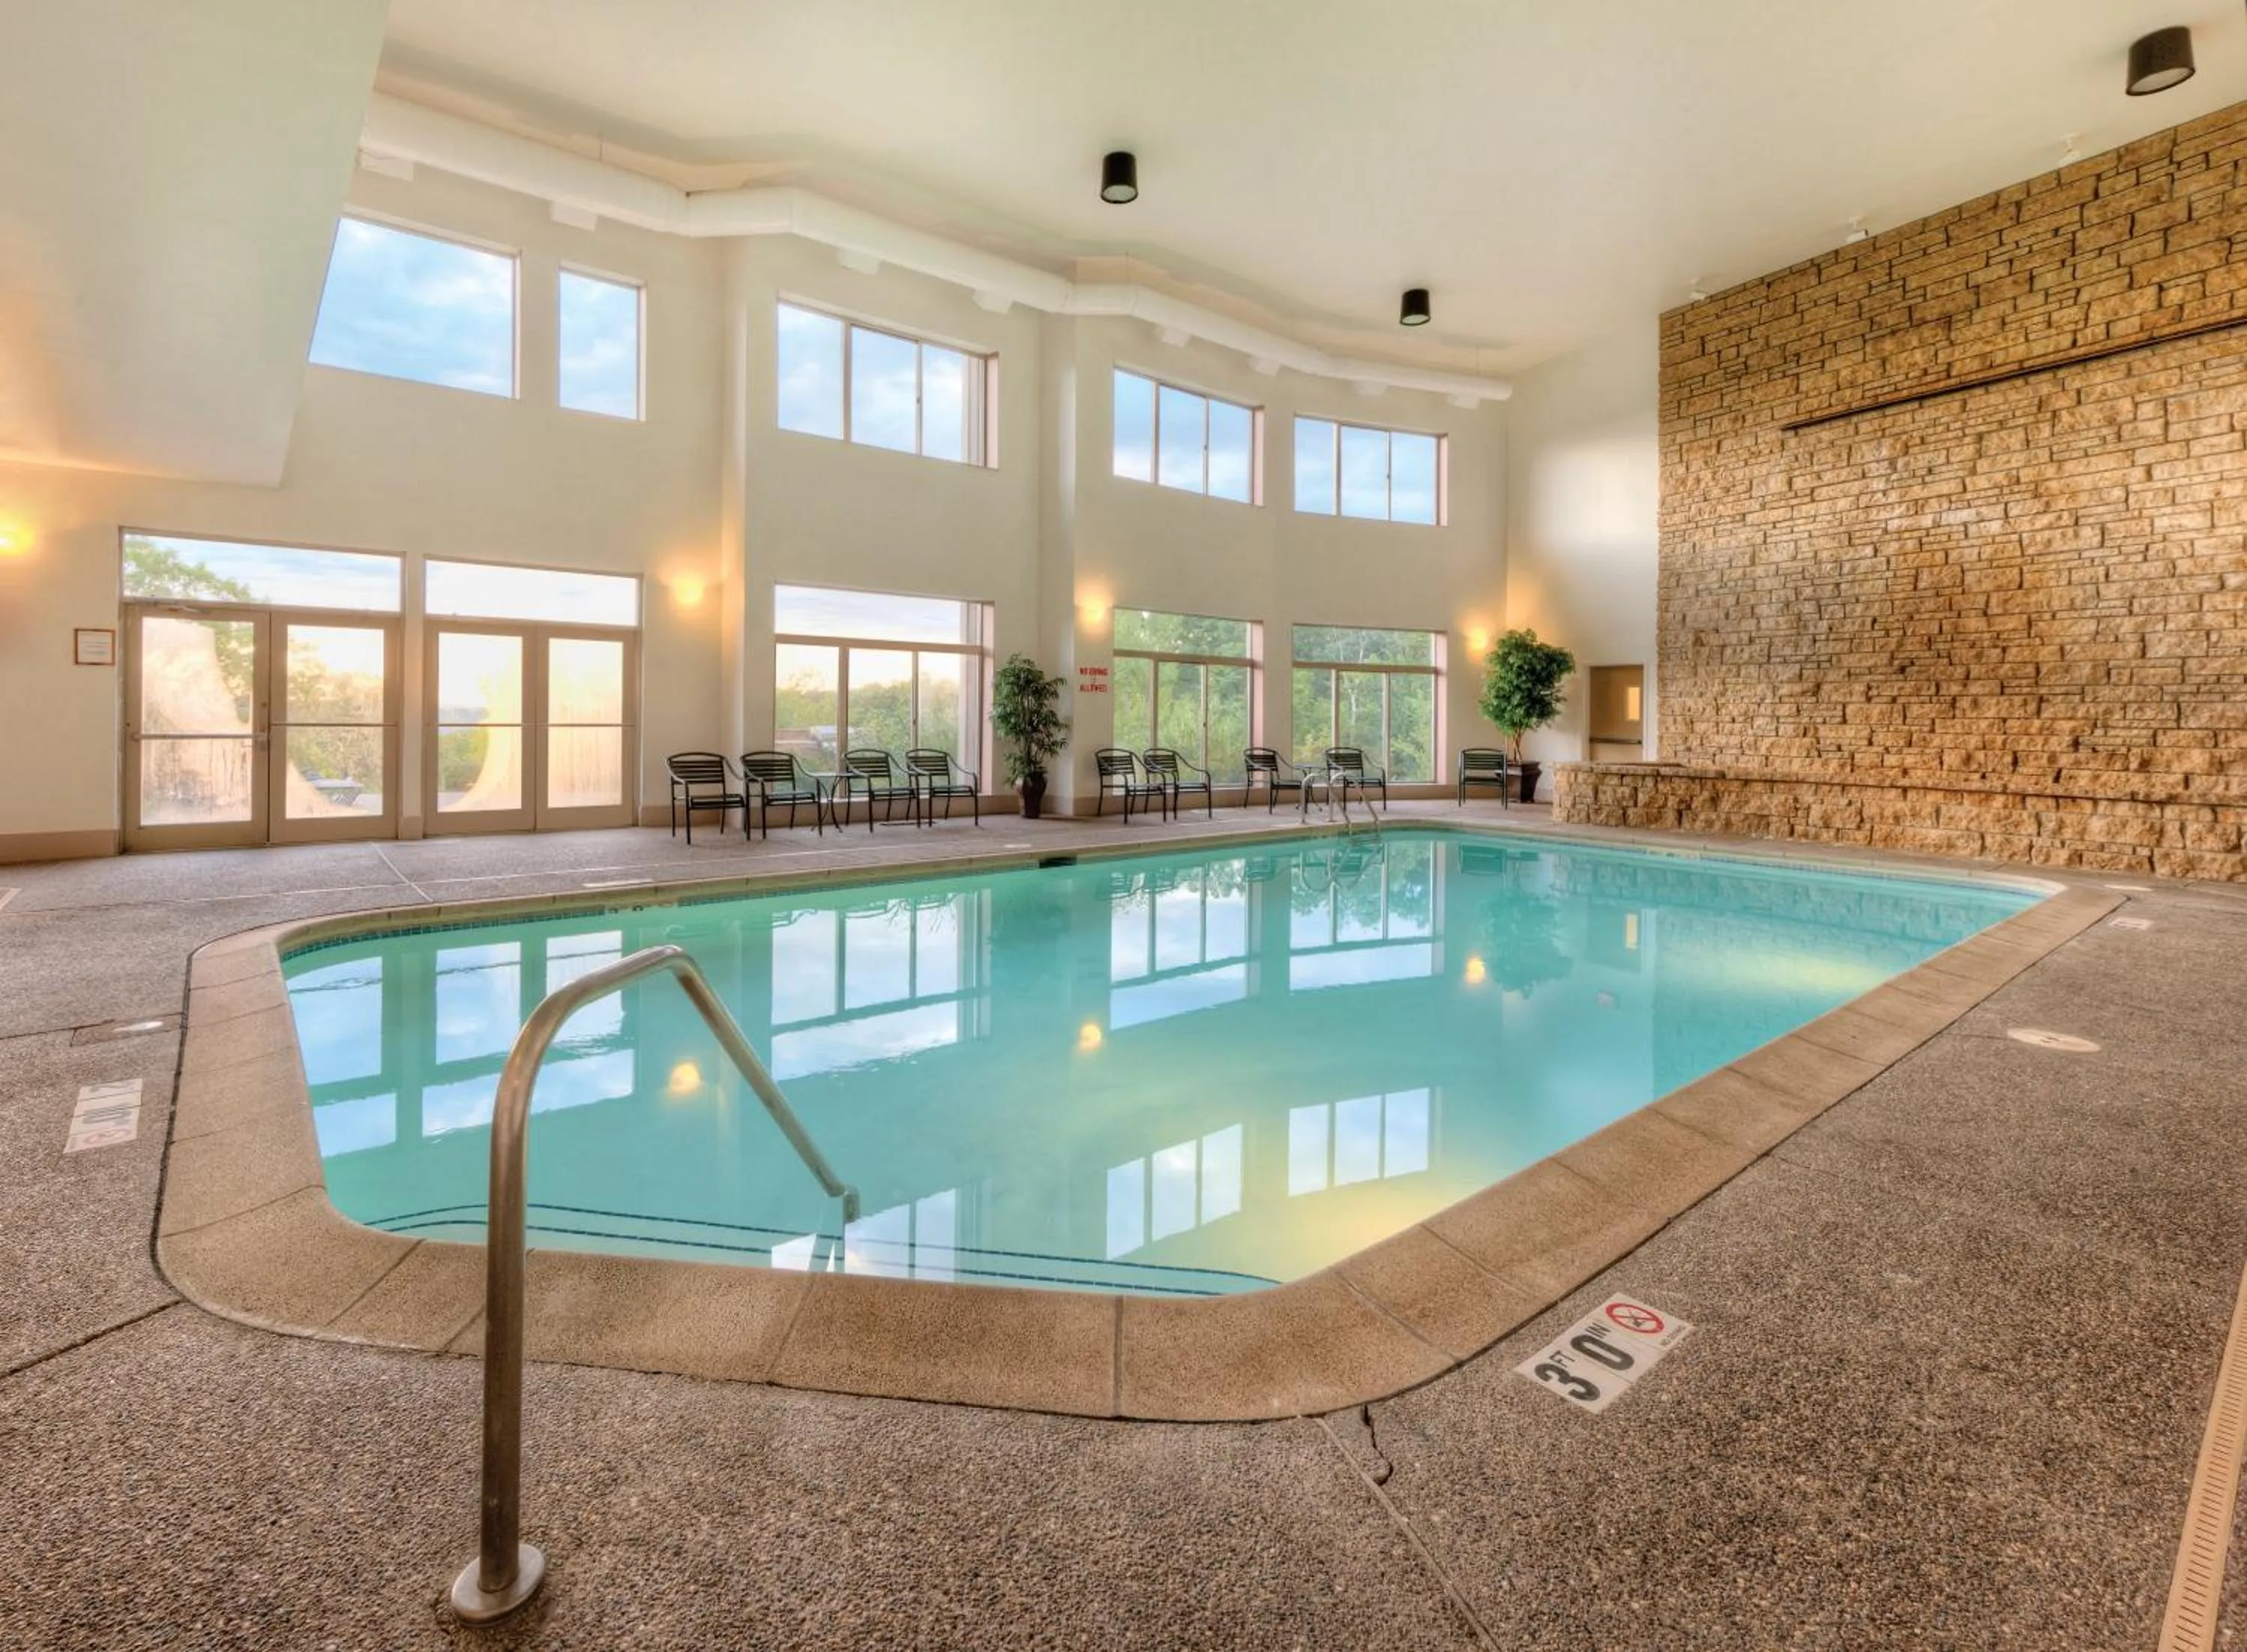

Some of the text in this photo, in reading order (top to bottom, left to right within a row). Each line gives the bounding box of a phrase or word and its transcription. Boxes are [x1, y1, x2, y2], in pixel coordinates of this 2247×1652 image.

[1079, 684, 1108, 693] ALLOWED
[1585, 1322, 1612, 1339] IN
[1549, 1350, 1575, 1368] FT
[1534, 1363, 1601, 1401] 3
